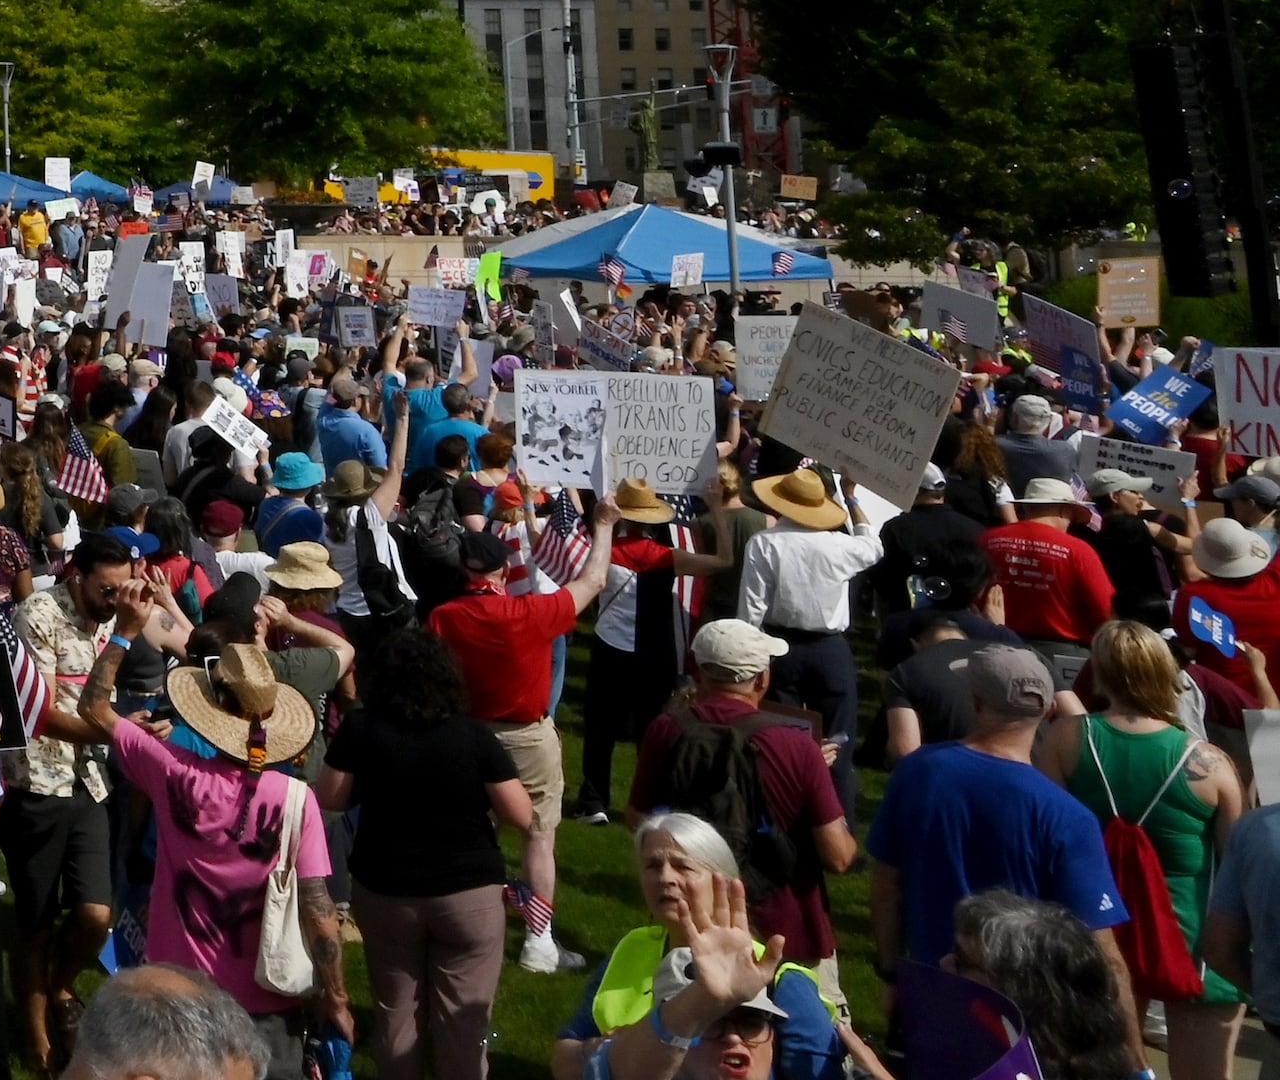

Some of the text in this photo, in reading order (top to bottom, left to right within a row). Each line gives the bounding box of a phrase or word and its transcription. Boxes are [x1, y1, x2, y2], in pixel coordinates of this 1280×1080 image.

[94, 254, 108, 265] NO
[439, 258, 465, 269] FUCK
[442, 270, 466, 281] ICE
[212, 285, 231, 300] NO
[850, 327, 909, 366] WE NEED
[743, 355, 782, 366] UNCHEC
[1072, 353, 1090, 368] WE
[795, 330, 948, 418] CIVICS EDUCATION
[526, 384, 598, 396] NEW YORKER
[608, 377, 703, 405] REBELLION TO
[823, 368, 897, 412] CAMPAIGN
[1062, 377, 1095, 397] PEOPL
[1163, 376, 1192, 398] WE
[797, 373, 916, 444] FINANCE REFORM
[1147, 391, 1179, 410] the
[614, 402, 712, 433] TYRANTS IS
[776, 386, 920, 471] PUBLIC SERVANTS
[617, 435, 703, 459] OBEDIENCE
[1122, 441, 1154, 455] Hate
[623, 460, 699, 484] TO GOD
[1117, 453, 1176, 471] Revenge
[1052, 544, 1070, 553] RUN
[1191, 607, 1202, 623] WE
[1212, 614, 1223, 645] PEOPLE
[117, 907, 146, 956] PEOP
